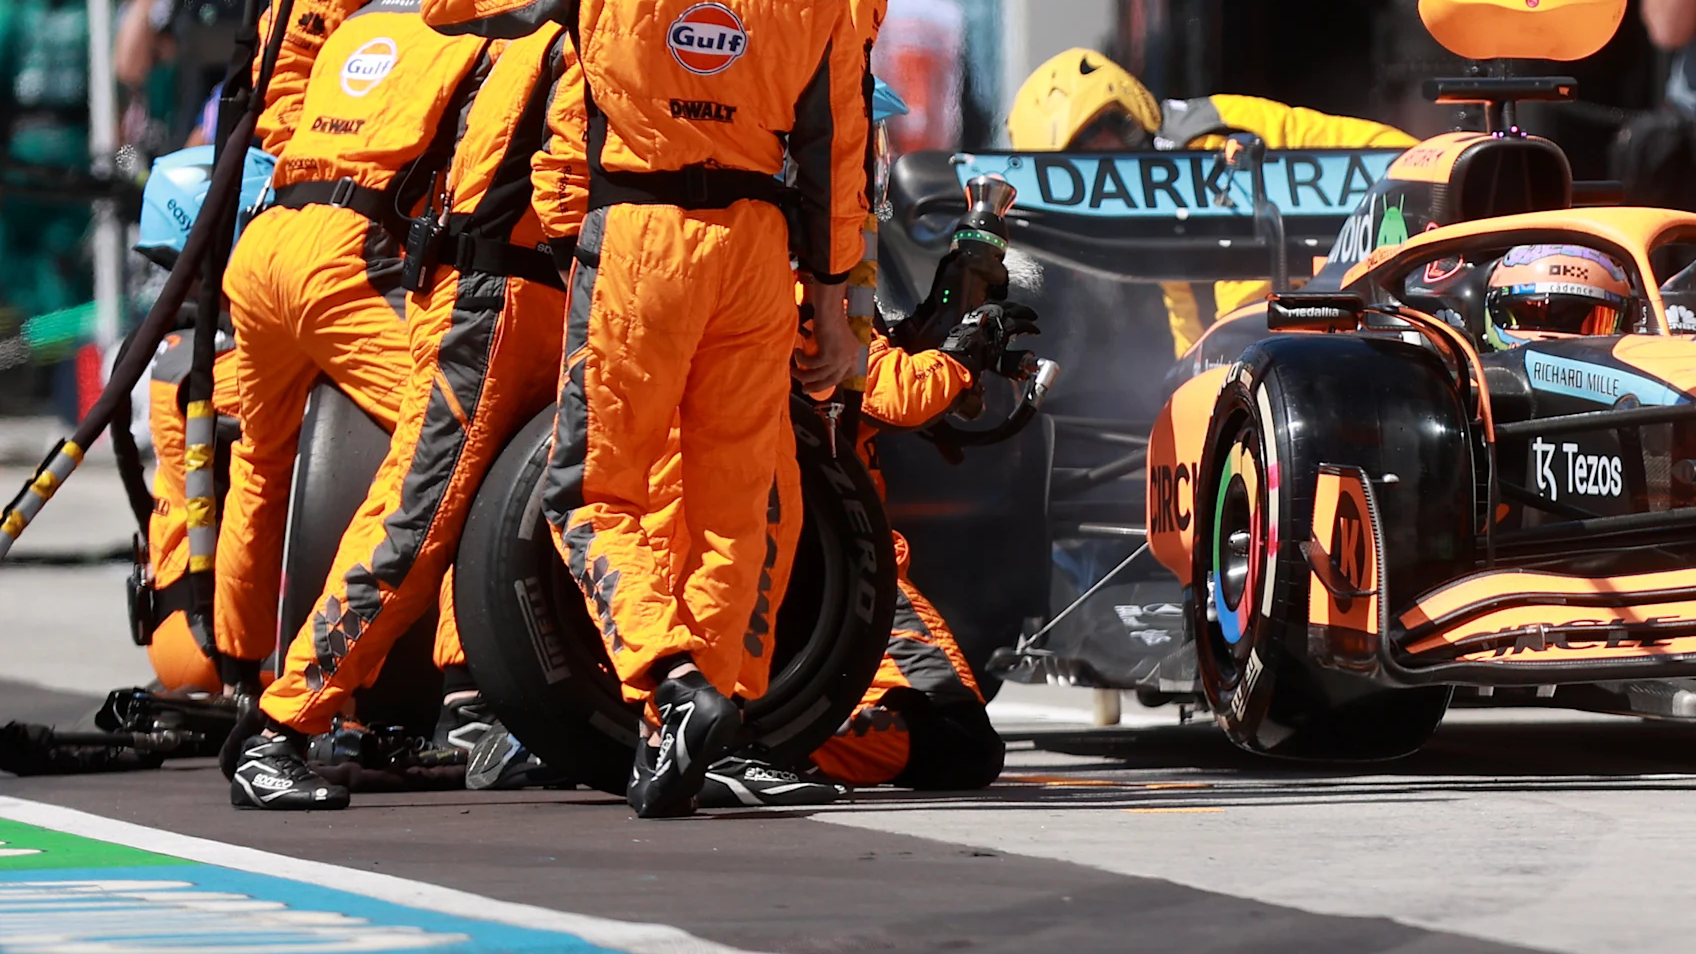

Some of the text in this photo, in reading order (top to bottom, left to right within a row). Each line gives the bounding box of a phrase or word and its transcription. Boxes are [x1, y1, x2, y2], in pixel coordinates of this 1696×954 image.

[671, 25, 744, 52] Gulf
[347, 57, 393, 76] Gulf
[310, 115, 366, 135] DeWALT
[166, 197, 193, 232] easy
[1549, 283, 1595, 296] cadence
[1533, 361, 1620, 398] RICHARD MILLE
[1561, 441, 1623, 497] Tezos
[1149, 461, 1200, 536] CIRC
[820, 461, 878, 626] ZERO
[251, 771, 296, 790] sparco
[743, 765, 799, 783] sparco
